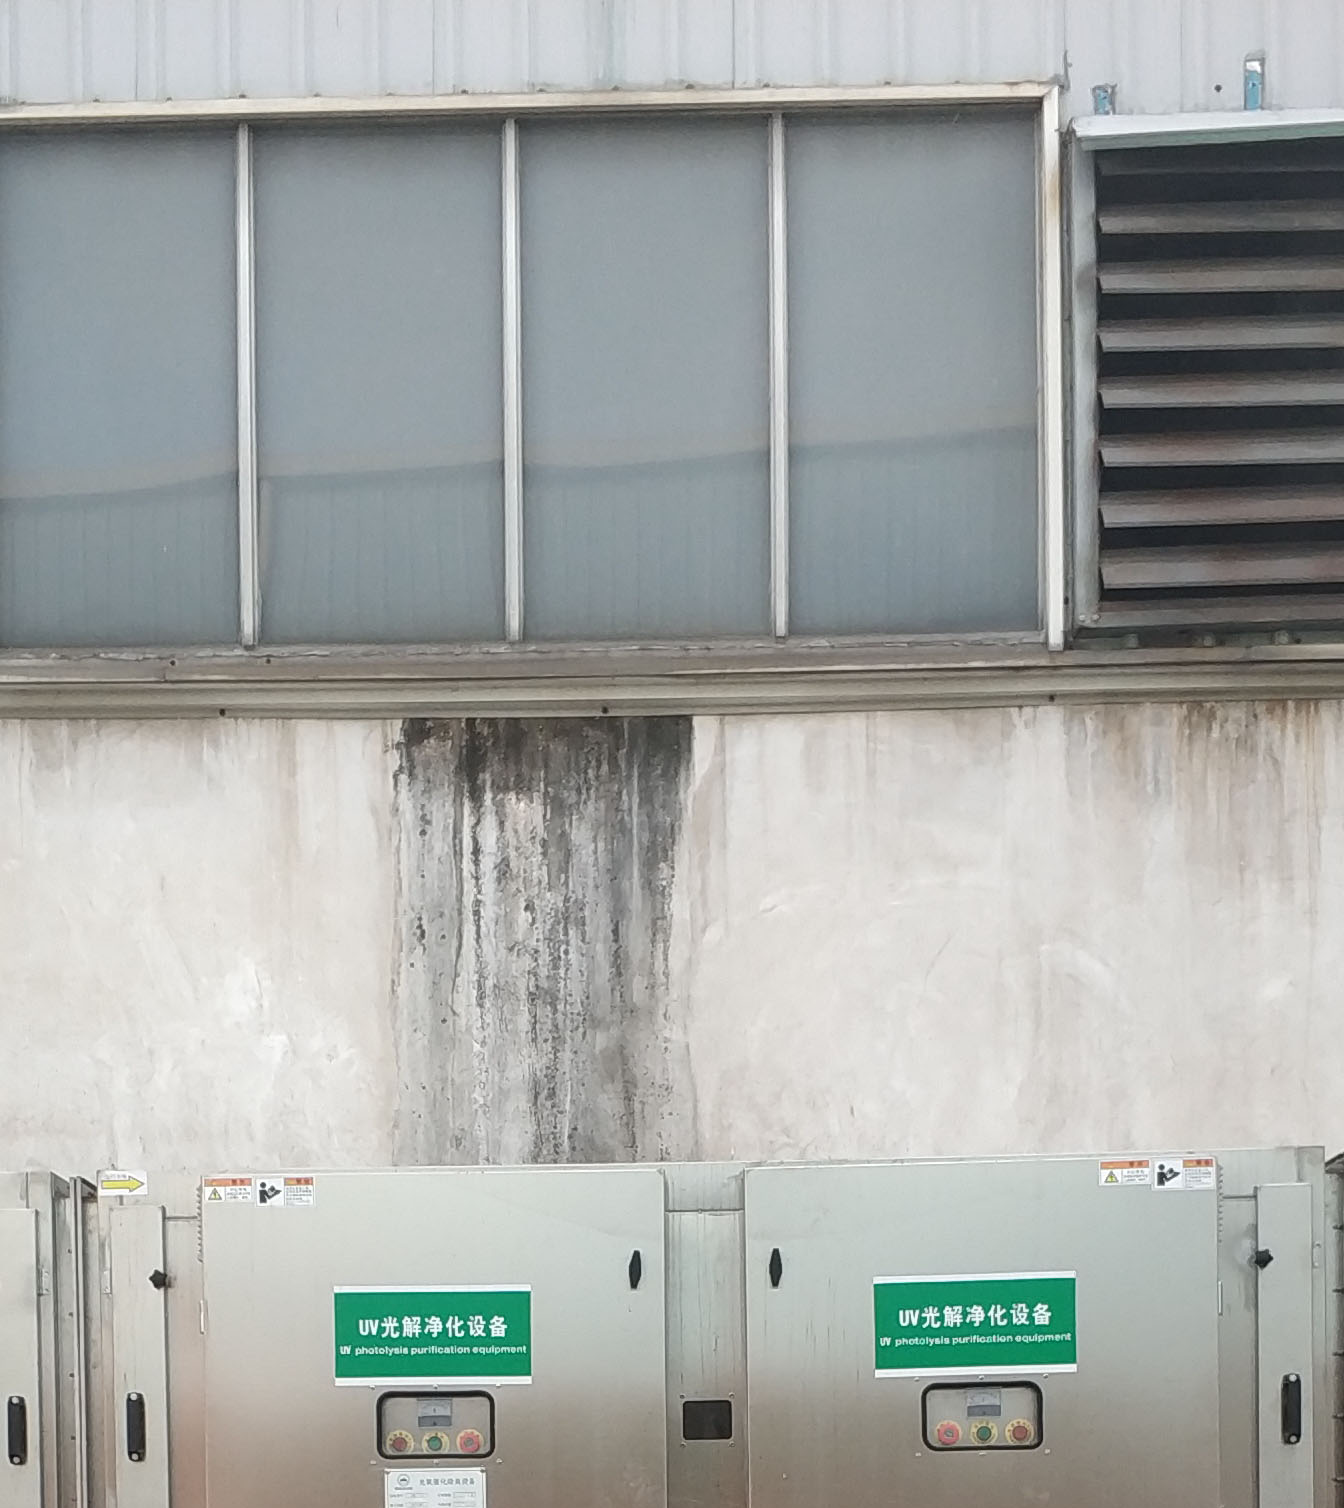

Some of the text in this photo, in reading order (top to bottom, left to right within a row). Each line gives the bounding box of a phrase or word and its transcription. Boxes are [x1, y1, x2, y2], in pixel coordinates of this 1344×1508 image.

[899, 1304, 1052, 1328] UV光解净化设备
[359, 1316, 507, 1338] UV光解净化设备
[880, 1337, 891, 1346] UV
[952, 1334, 1013, 1345] purification
[1015, 1333, 1071, 1343] equipment
[340, 1346, 351, 1354] UV
[411, 1345, 470, 1356] purification
[472, 1345, 527, 1355] equipment
